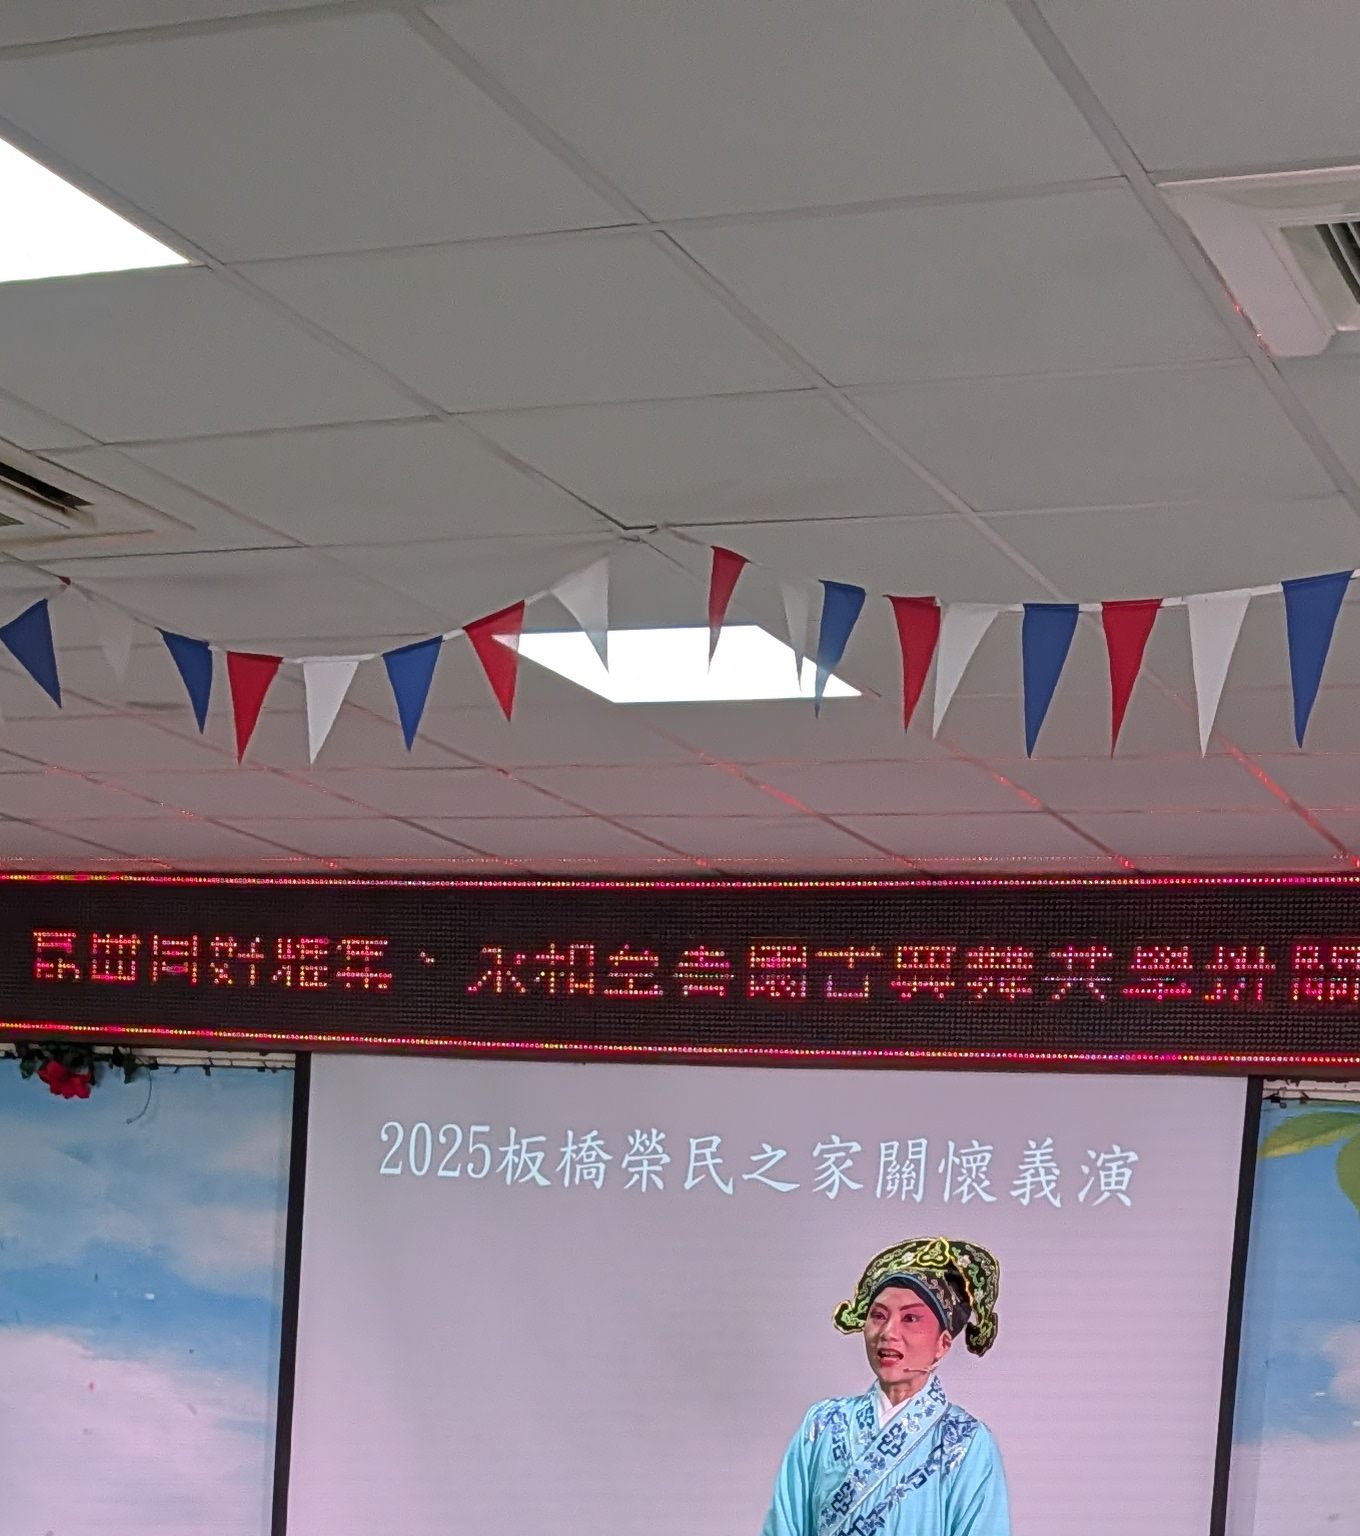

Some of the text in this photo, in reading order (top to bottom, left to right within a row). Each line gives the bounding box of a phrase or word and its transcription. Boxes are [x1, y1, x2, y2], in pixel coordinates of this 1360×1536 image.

[378, 1119, 1139, 1209] 2025板橋榮民之家關懷義演
